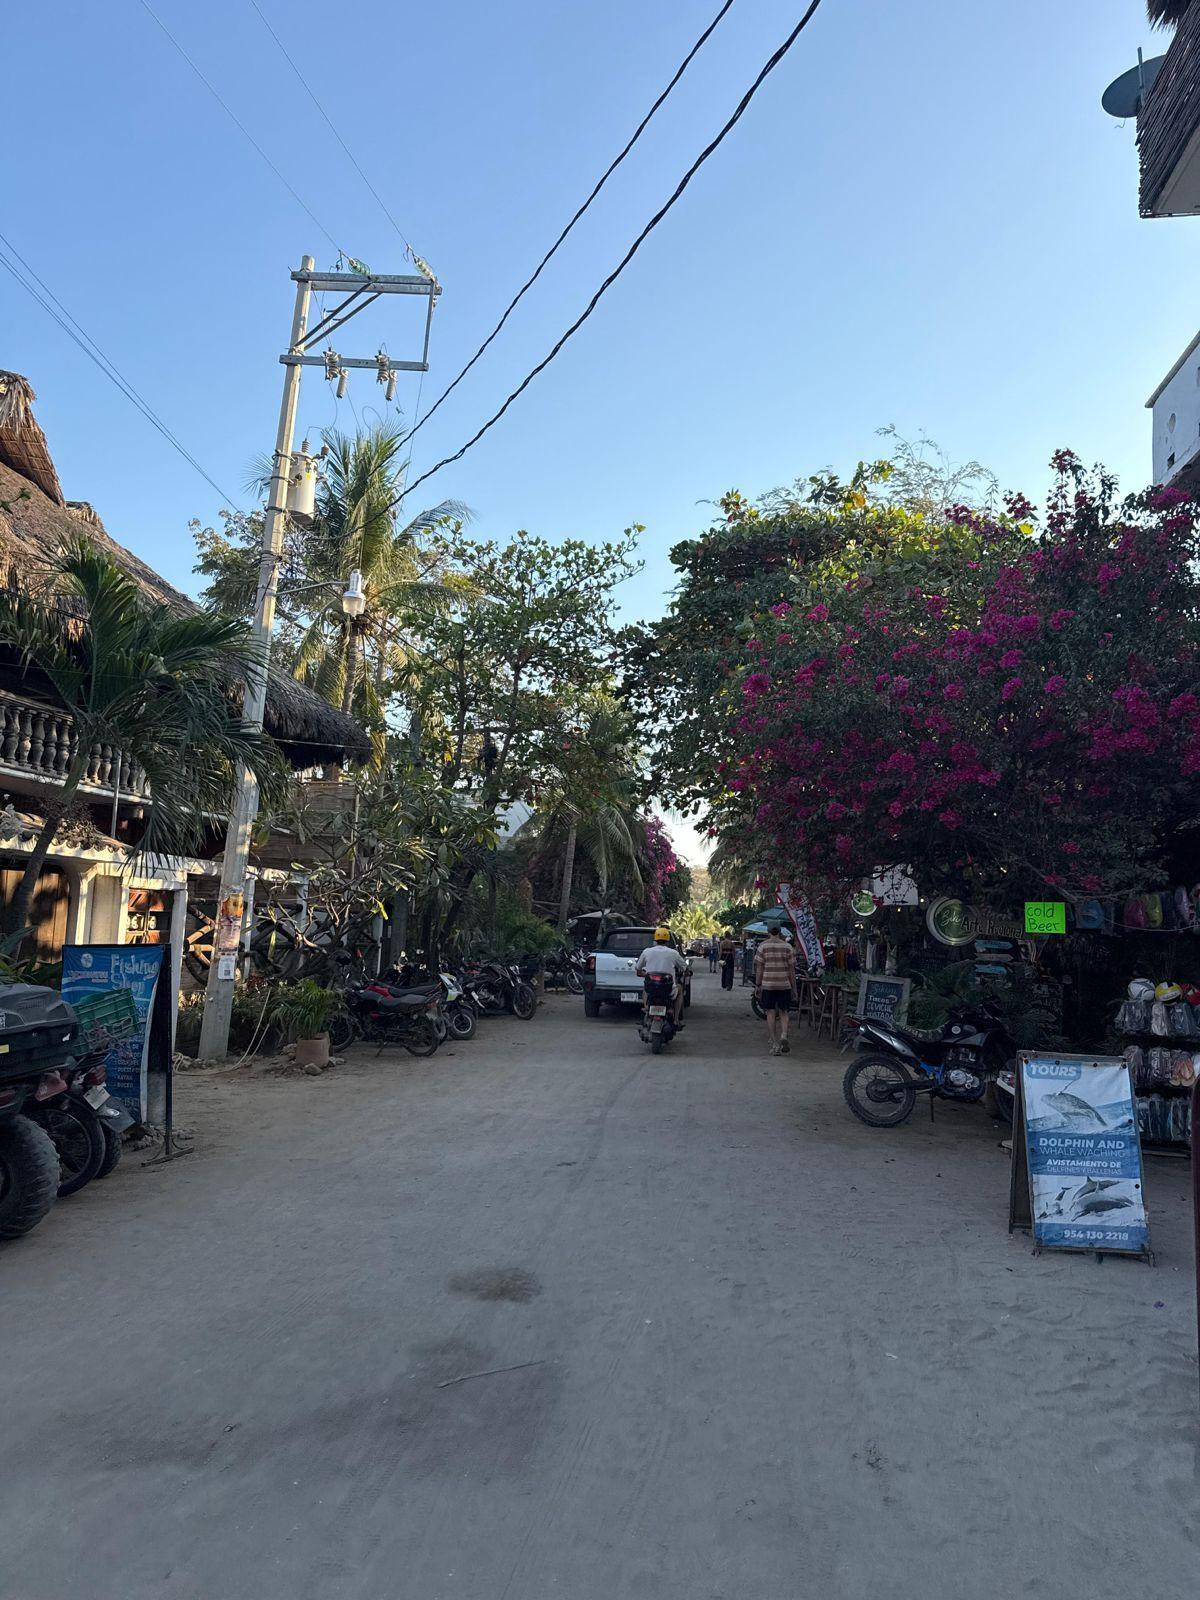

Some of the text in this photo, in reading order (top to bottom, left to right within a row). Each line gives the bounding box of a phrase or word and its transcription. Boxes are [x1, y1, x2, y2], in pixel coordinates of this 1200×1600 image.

[1026, 903, 1054, 918] cold
[1028, 918, 1060, 932] Beer
[1030, 1064, 1078, 1077] TOURS
[1040, 1137, 1125, 1150] DOLPHIN AND
[1040, 1147, 1126, 1158] WHALE WACHING
[1046, 1158, 1122, 1169] AVISTAMIENTO DE
[1063, 1229, 1084, 1239] 954
[1086, 1230, 1103, 1239] 130
[1105, 1231, 1129, 1241] 2218
